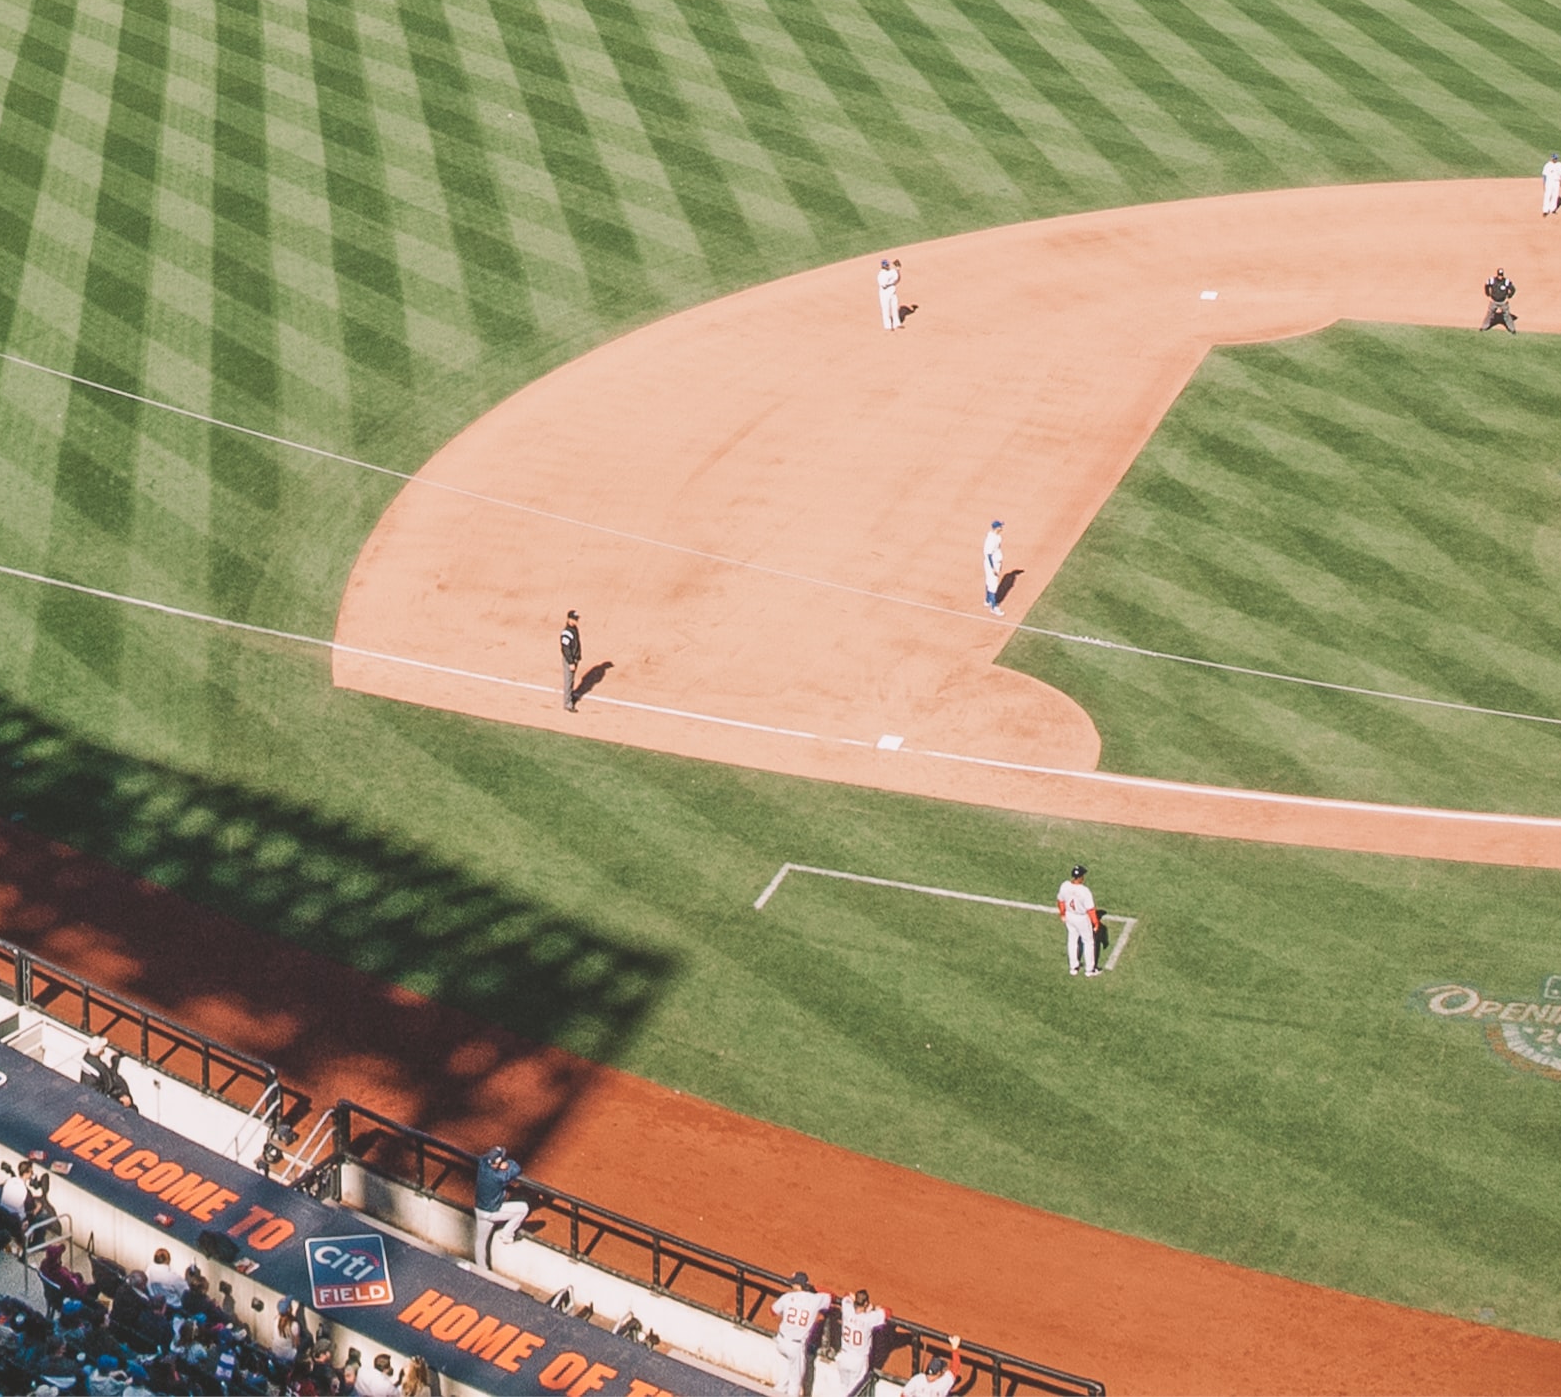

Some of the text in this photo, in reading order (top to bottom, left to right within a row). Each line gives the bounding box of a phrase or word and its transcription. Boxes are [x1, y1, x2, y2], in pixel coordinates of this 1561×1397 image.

[47, 1112, 296, 1251] WELCOME TO
[313, 1245, 375, 1281] citi
[317, 1284, 388, 1302] FIELD
[786, 1306, 809, 1328] 28
[397, 1287, 618, 1397] HOME OF
